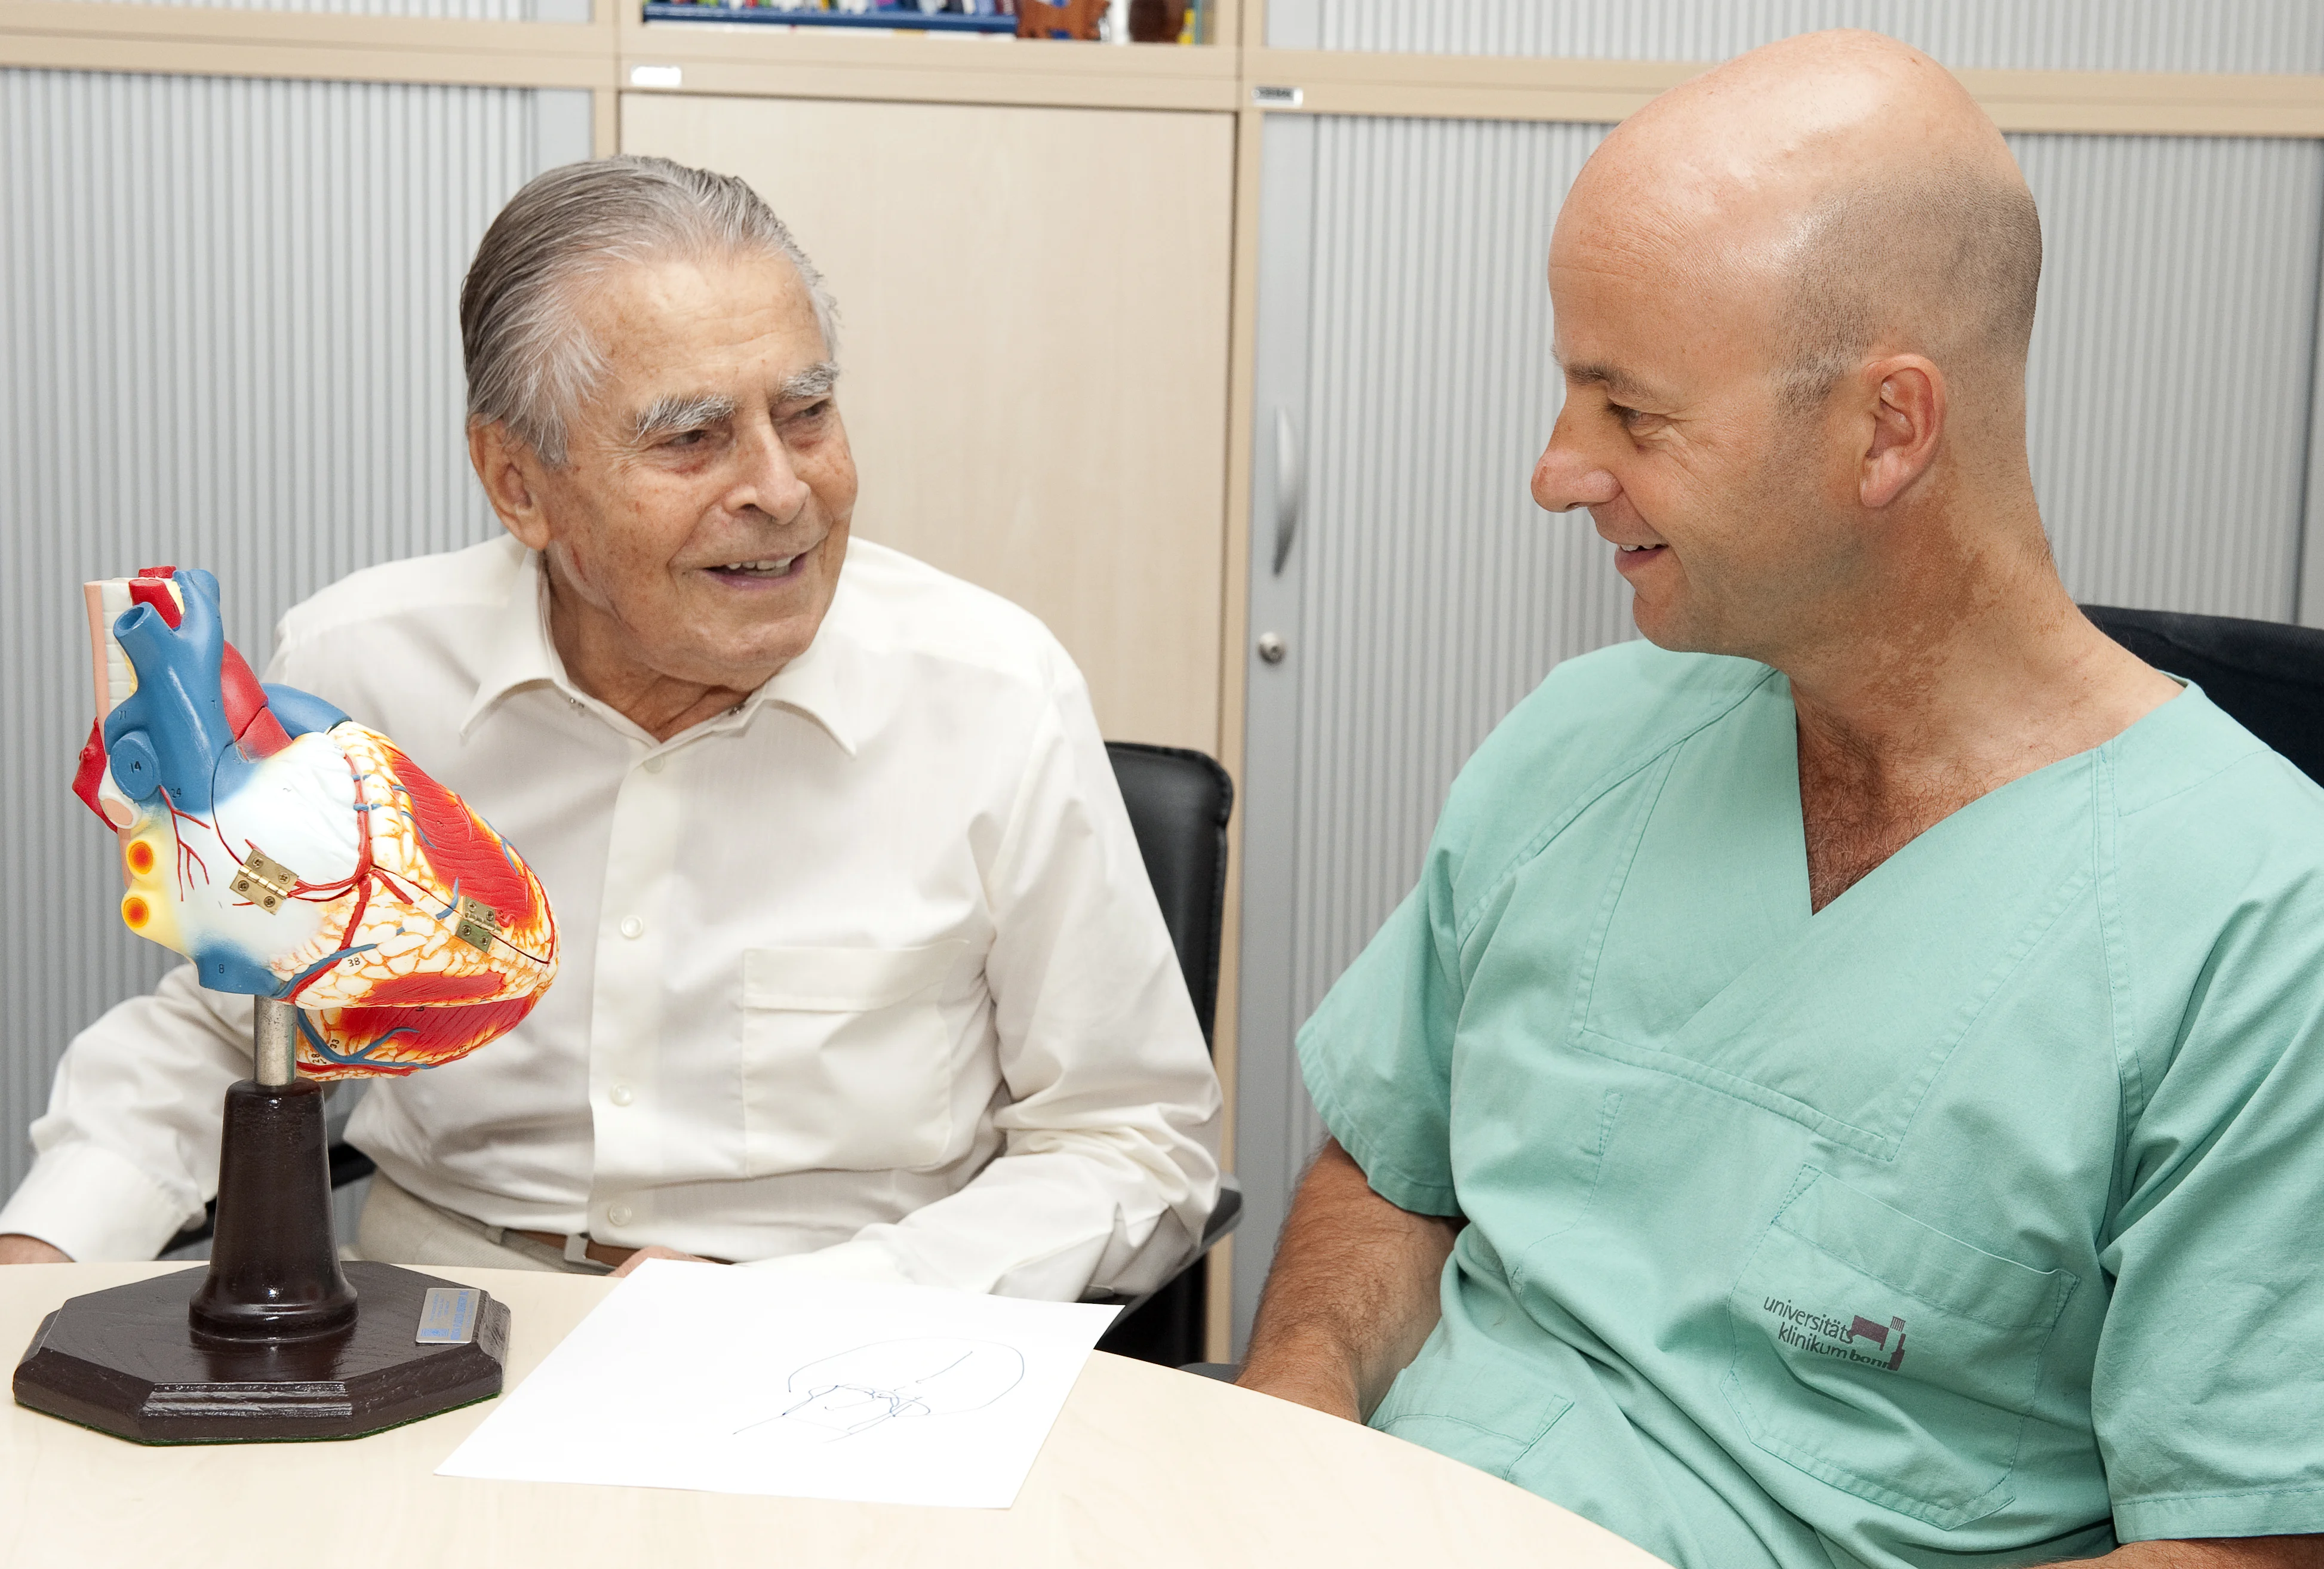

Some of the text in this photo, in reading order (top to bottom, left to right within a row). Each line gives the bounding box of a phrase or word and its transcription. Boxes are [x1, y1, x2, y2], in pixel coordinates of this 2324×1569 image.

[348, 957, 361, 967] 38
[219, 964, 225, 974] 8
[330, 1039, 340, 1049] 33
[311, 1053, 321, 1063] 28
[1763, 1296, 1853, 1345] universitäts
[1778, 1322, 1847, 1359] klinikum
